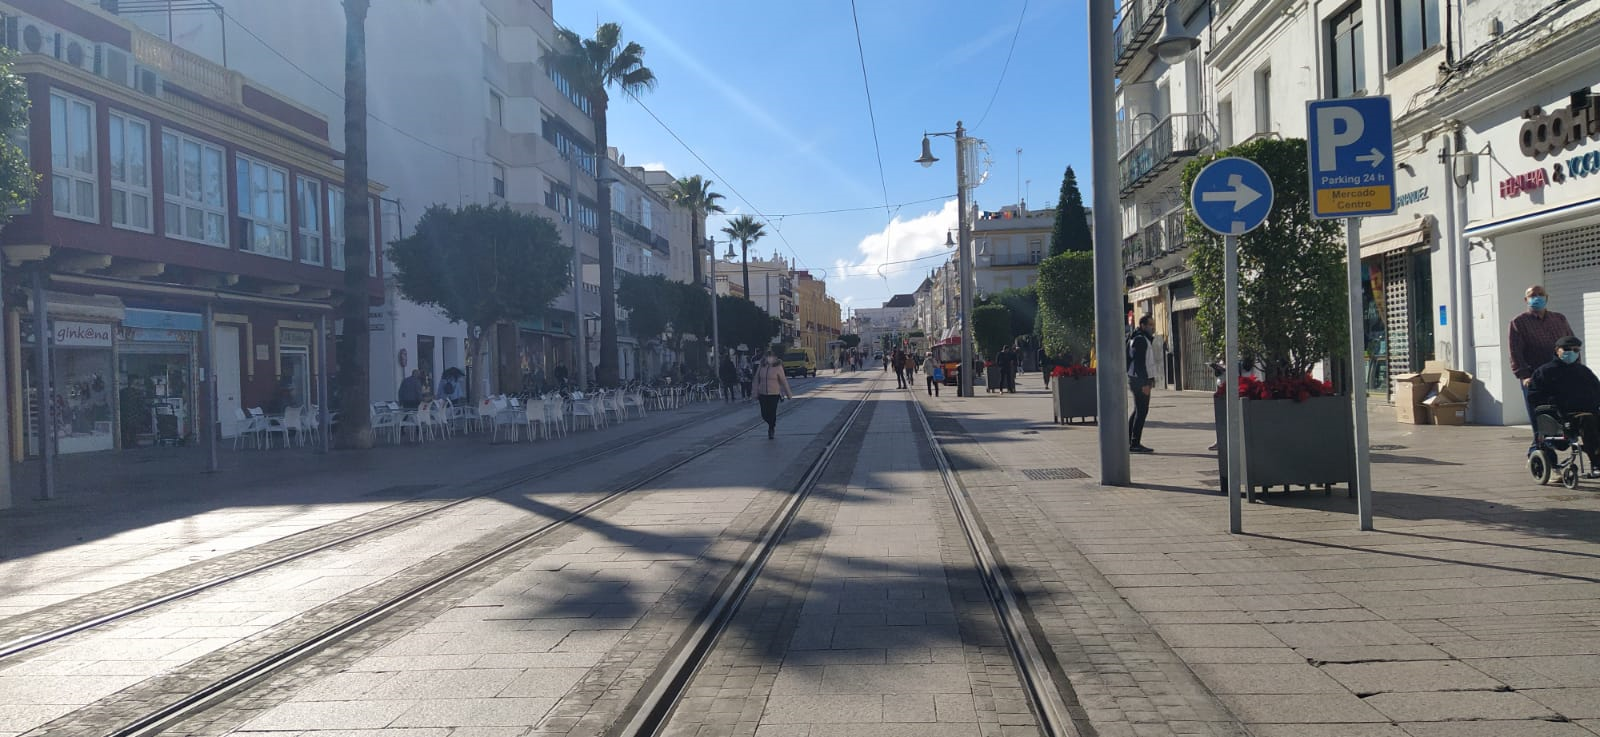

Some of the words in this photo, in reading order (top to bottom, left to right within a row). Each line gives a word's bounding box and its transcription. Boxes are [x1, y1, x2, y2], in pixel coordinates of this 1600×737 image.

[1316, 106, 1364, 172] P
[1321, 175, 1361, 185] Parking
[1363, 173, 1375, 183] 24
[1378, 172, 1385, 182] h
[1553, 163, 1566, 184] &
[1332, 189, 1376, 199] Mercado
[1337, 201, 1372, 210] Centro
[57, 326, 110, 342] gink@na
